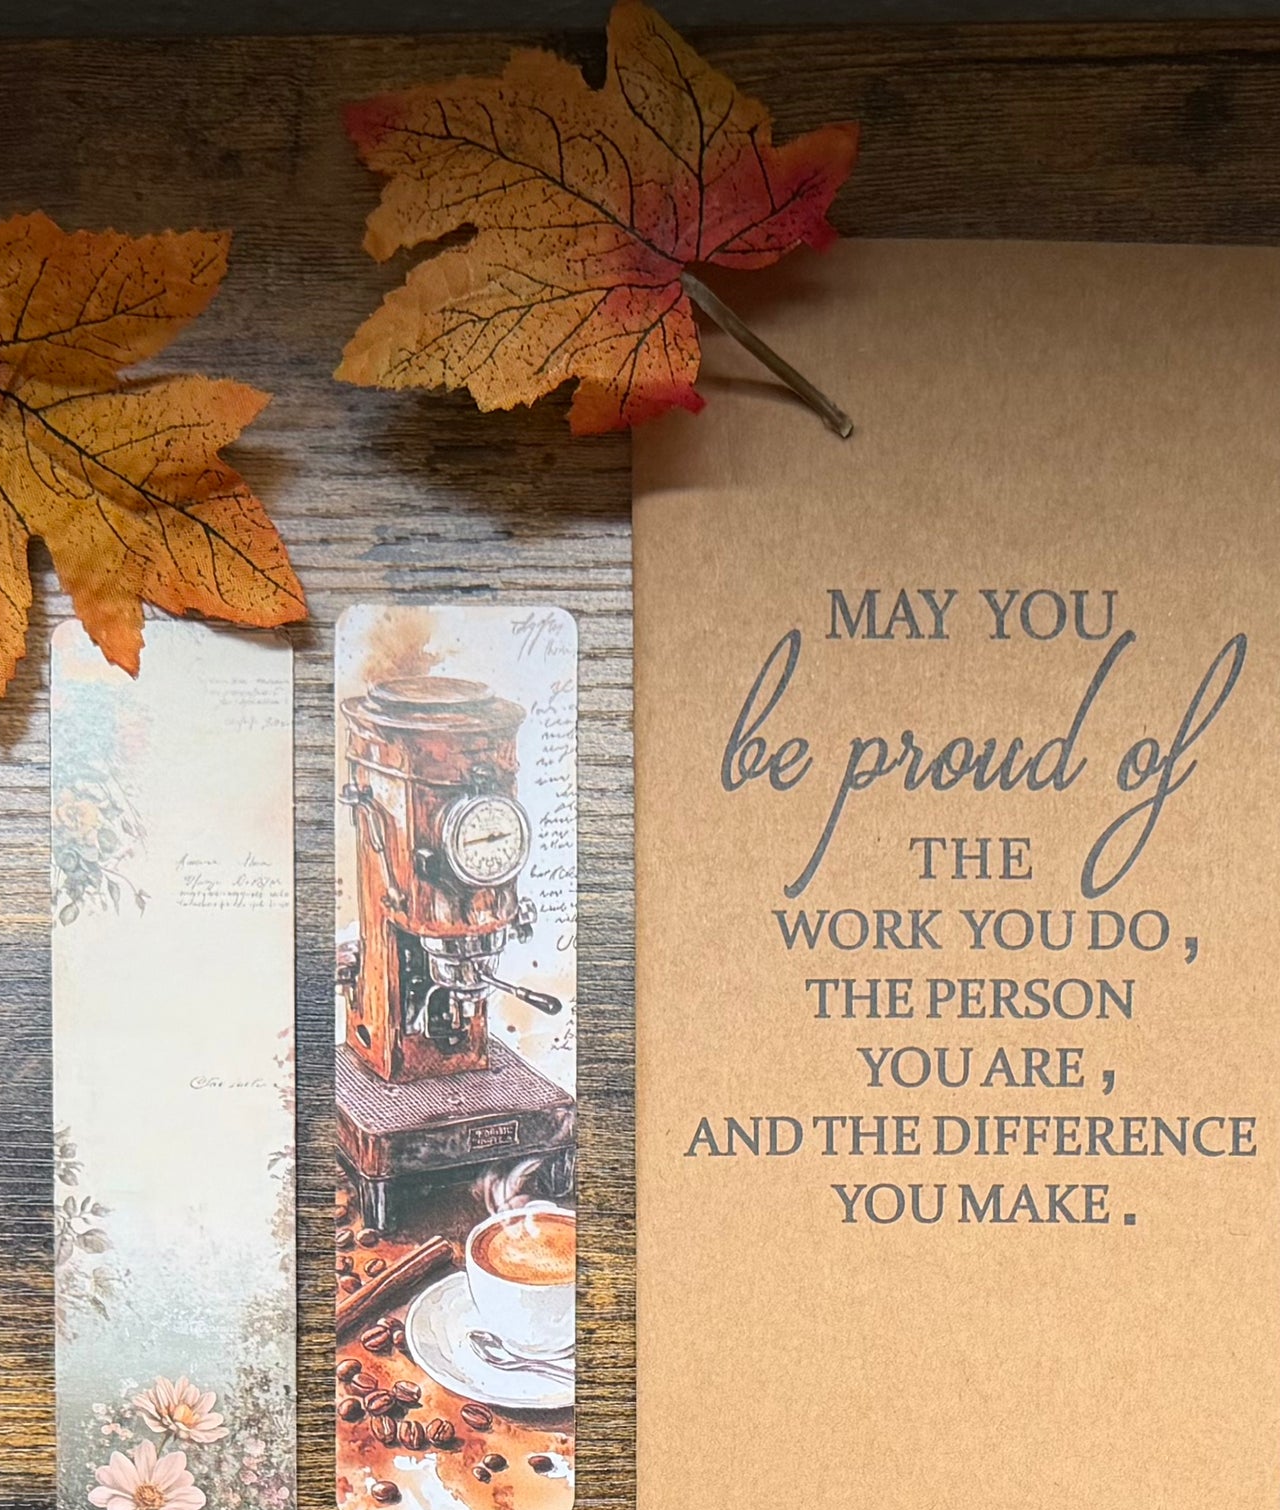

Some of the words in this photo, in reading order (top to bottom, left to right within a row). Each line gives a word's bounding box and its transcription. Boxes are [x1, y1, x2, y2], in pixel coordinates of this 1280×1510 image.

[825, 588, 958, 640] MAY
[979, 588, 1119, 640] YOU
[721, 629, 812, 793] be
[784, 630, 1137, 899] proud
[1080, 632, 1248, 899] of
[909, 836, 1033, 880] THE
[773, 908, 944, 951] WORK
[966, 908, 1075, 951] YOU
[805, 977, 913, 1020] THE
[926, 977, 1135, 1020] PERSON
[857, 1046, 971, 1088] YOU
[683, 1115, 804, 1158] AND
[812, 1115, 923, 1158] THE
[932, 1115, 1258, 1158] DIFFERENCE
[831, 1183, 945, 1227] YOU
